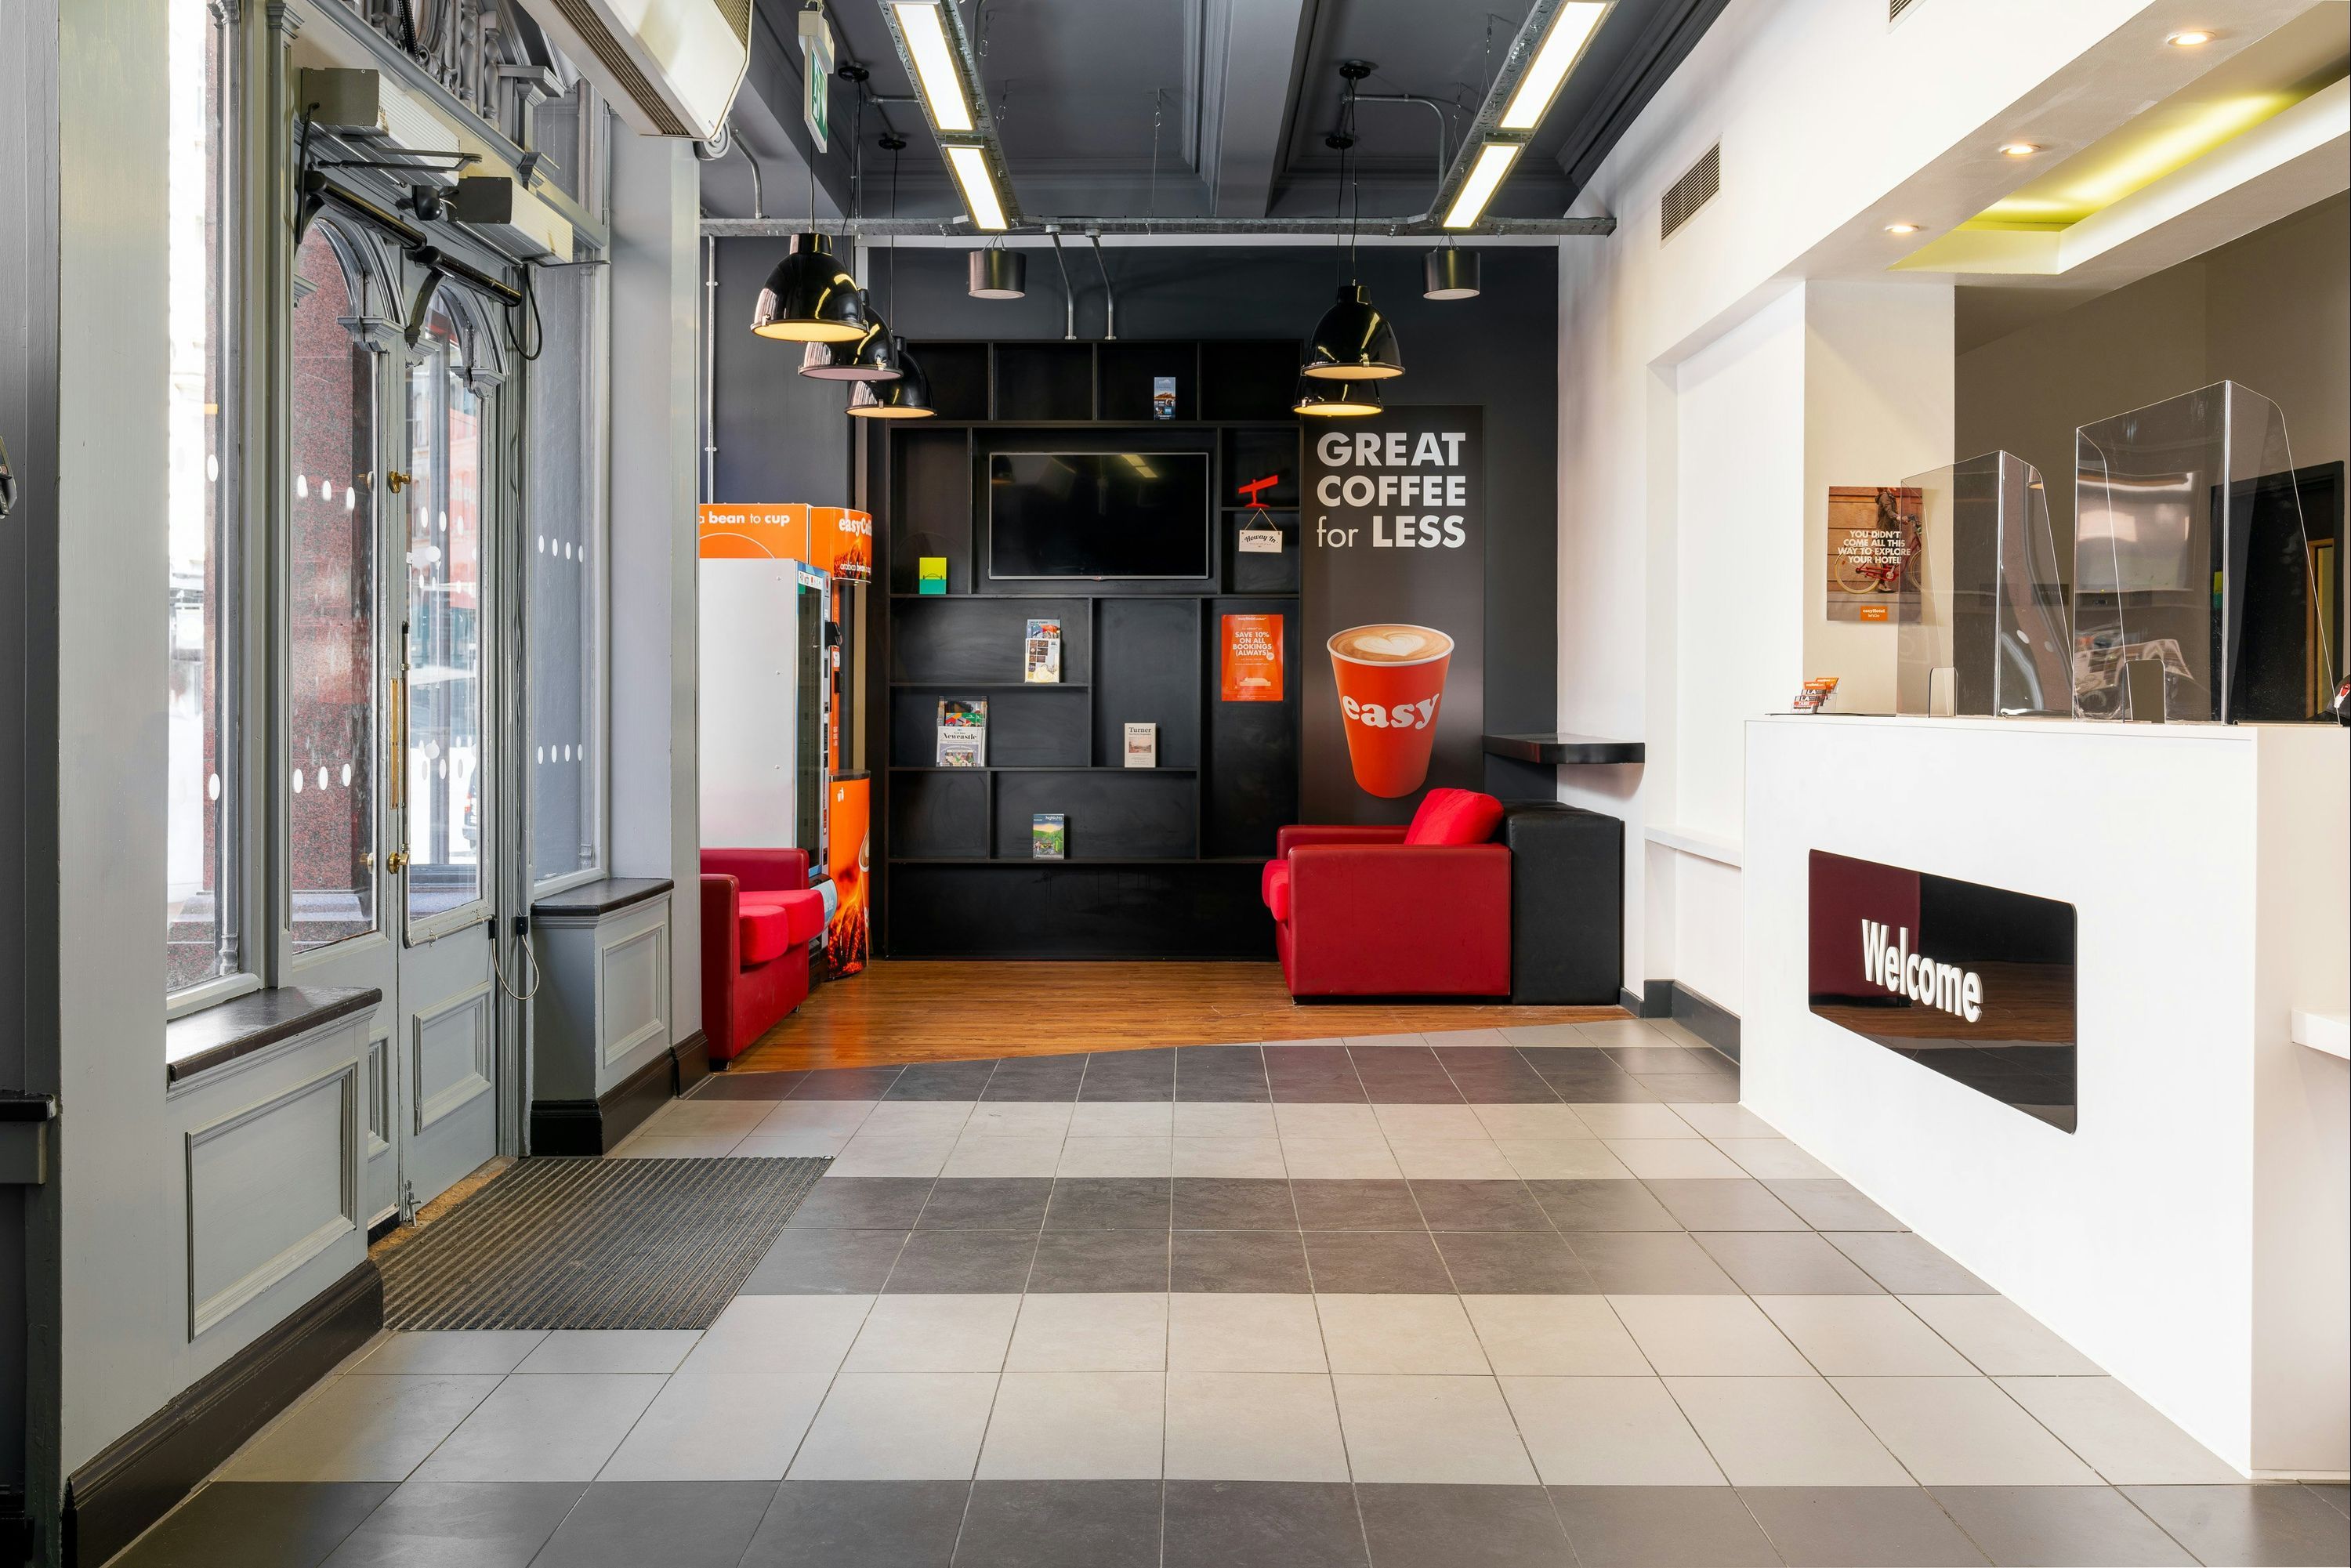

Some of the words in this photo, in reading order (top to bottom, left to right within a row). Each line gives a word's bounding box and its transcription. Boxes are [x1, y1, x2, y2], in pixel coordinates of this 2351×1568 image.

[1317, 432, 1465, 467] GREAT
[1317, 475, 1465, 507] COFFEE
[708, 511, 744, 523] bean
[750, 513, 761, 523] to
[764, 515, 790, 527] cup
[1317, 516, 1359, 547] for
[1373, 515, 1465, 549] LESS
[1342, 693, 1440, 730] easy
[1862, 918, 1983, 1023] Welcome
